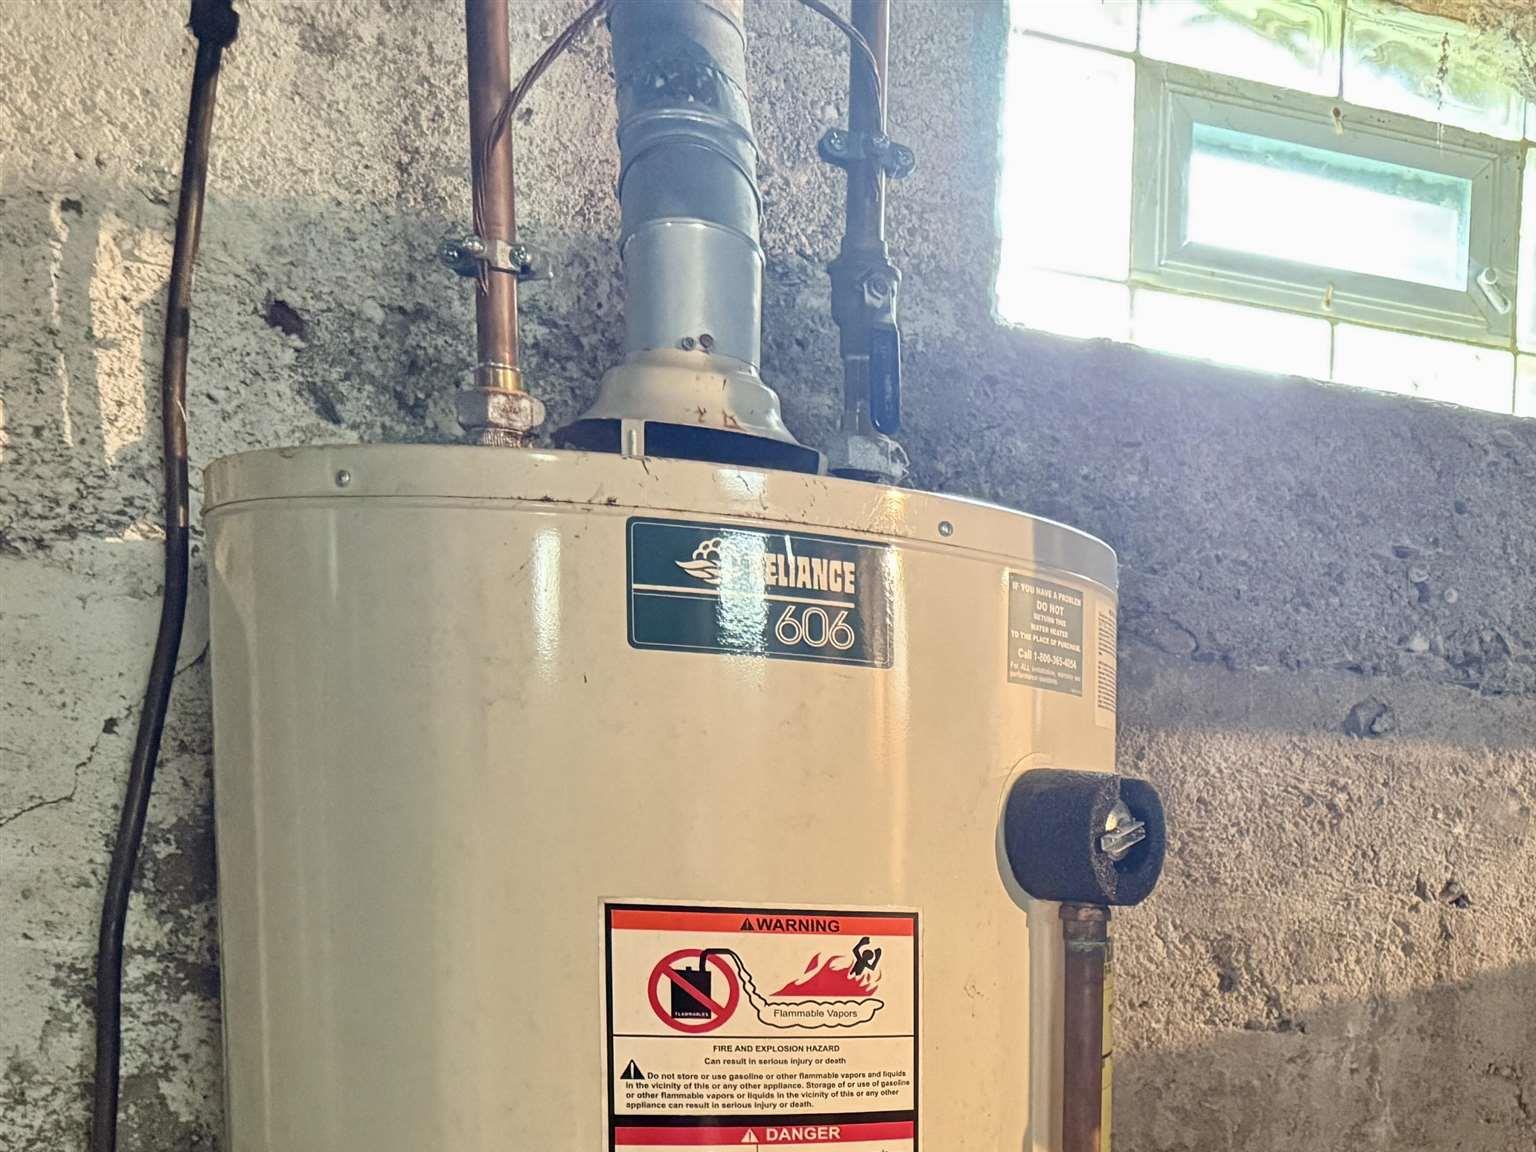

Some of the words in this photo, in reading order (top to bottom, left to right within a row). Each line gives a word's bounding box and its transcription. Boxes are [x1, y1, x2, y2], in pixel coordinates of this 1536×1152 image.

[760, 552, 855, 594] ELIANCE
[1036, 601, 1047, 611] DO
[775, 605, 855, 651] 606
[1018, 648, 1032, 659] Call
[756, 918, 841, 933] WARNING
[773, 1009, 824, 1018] Flammable
[827, 1009, 858, 1020] Vapors
[713, 1045, 732, 1053] FIRE
[735, 1045, 753, 1053] AND
[755, 1045, 804, 1053] EXPLOSION
[806, 1045, 840, 1053] HAZARD
[704, 1057, 721, 1065] Can
[723, 1057, 747, 1065] result
[749, 1057, 757, 1065] in
[759, 1057, 788, 1065] serious
[790, 1057, 812, 1066] injury
[825, 1057, 847, 1065] death
[647, 1072, 659, 1080] Do
[661, 1072, 675, 1080] not
[677, 1072, 698, 1080] store
[729, 1072, 764, 1081] gasoline
[883, 1070, 906, 1078] liquids
[651, 1082, 681, 1090] vicinity
[740, 1081, 761, 1089] other
[763, 1082, 804, 1090] appliance.
[806, 1081, 836, 1089] Storage
[881, 1079, 910, 1088] gasoline
[661, 1091, 704, 1099] flammable
[747, 1091, 774, 1099] liquids
[801, 1091, 829, 1099] vicinity
[626, 1101, 666, 1109] appliance
[721, 1101, 752, 1109] serious
[754, 1101, 777, 1109] injury
[766, 1127, 841, 1142] DANGER
